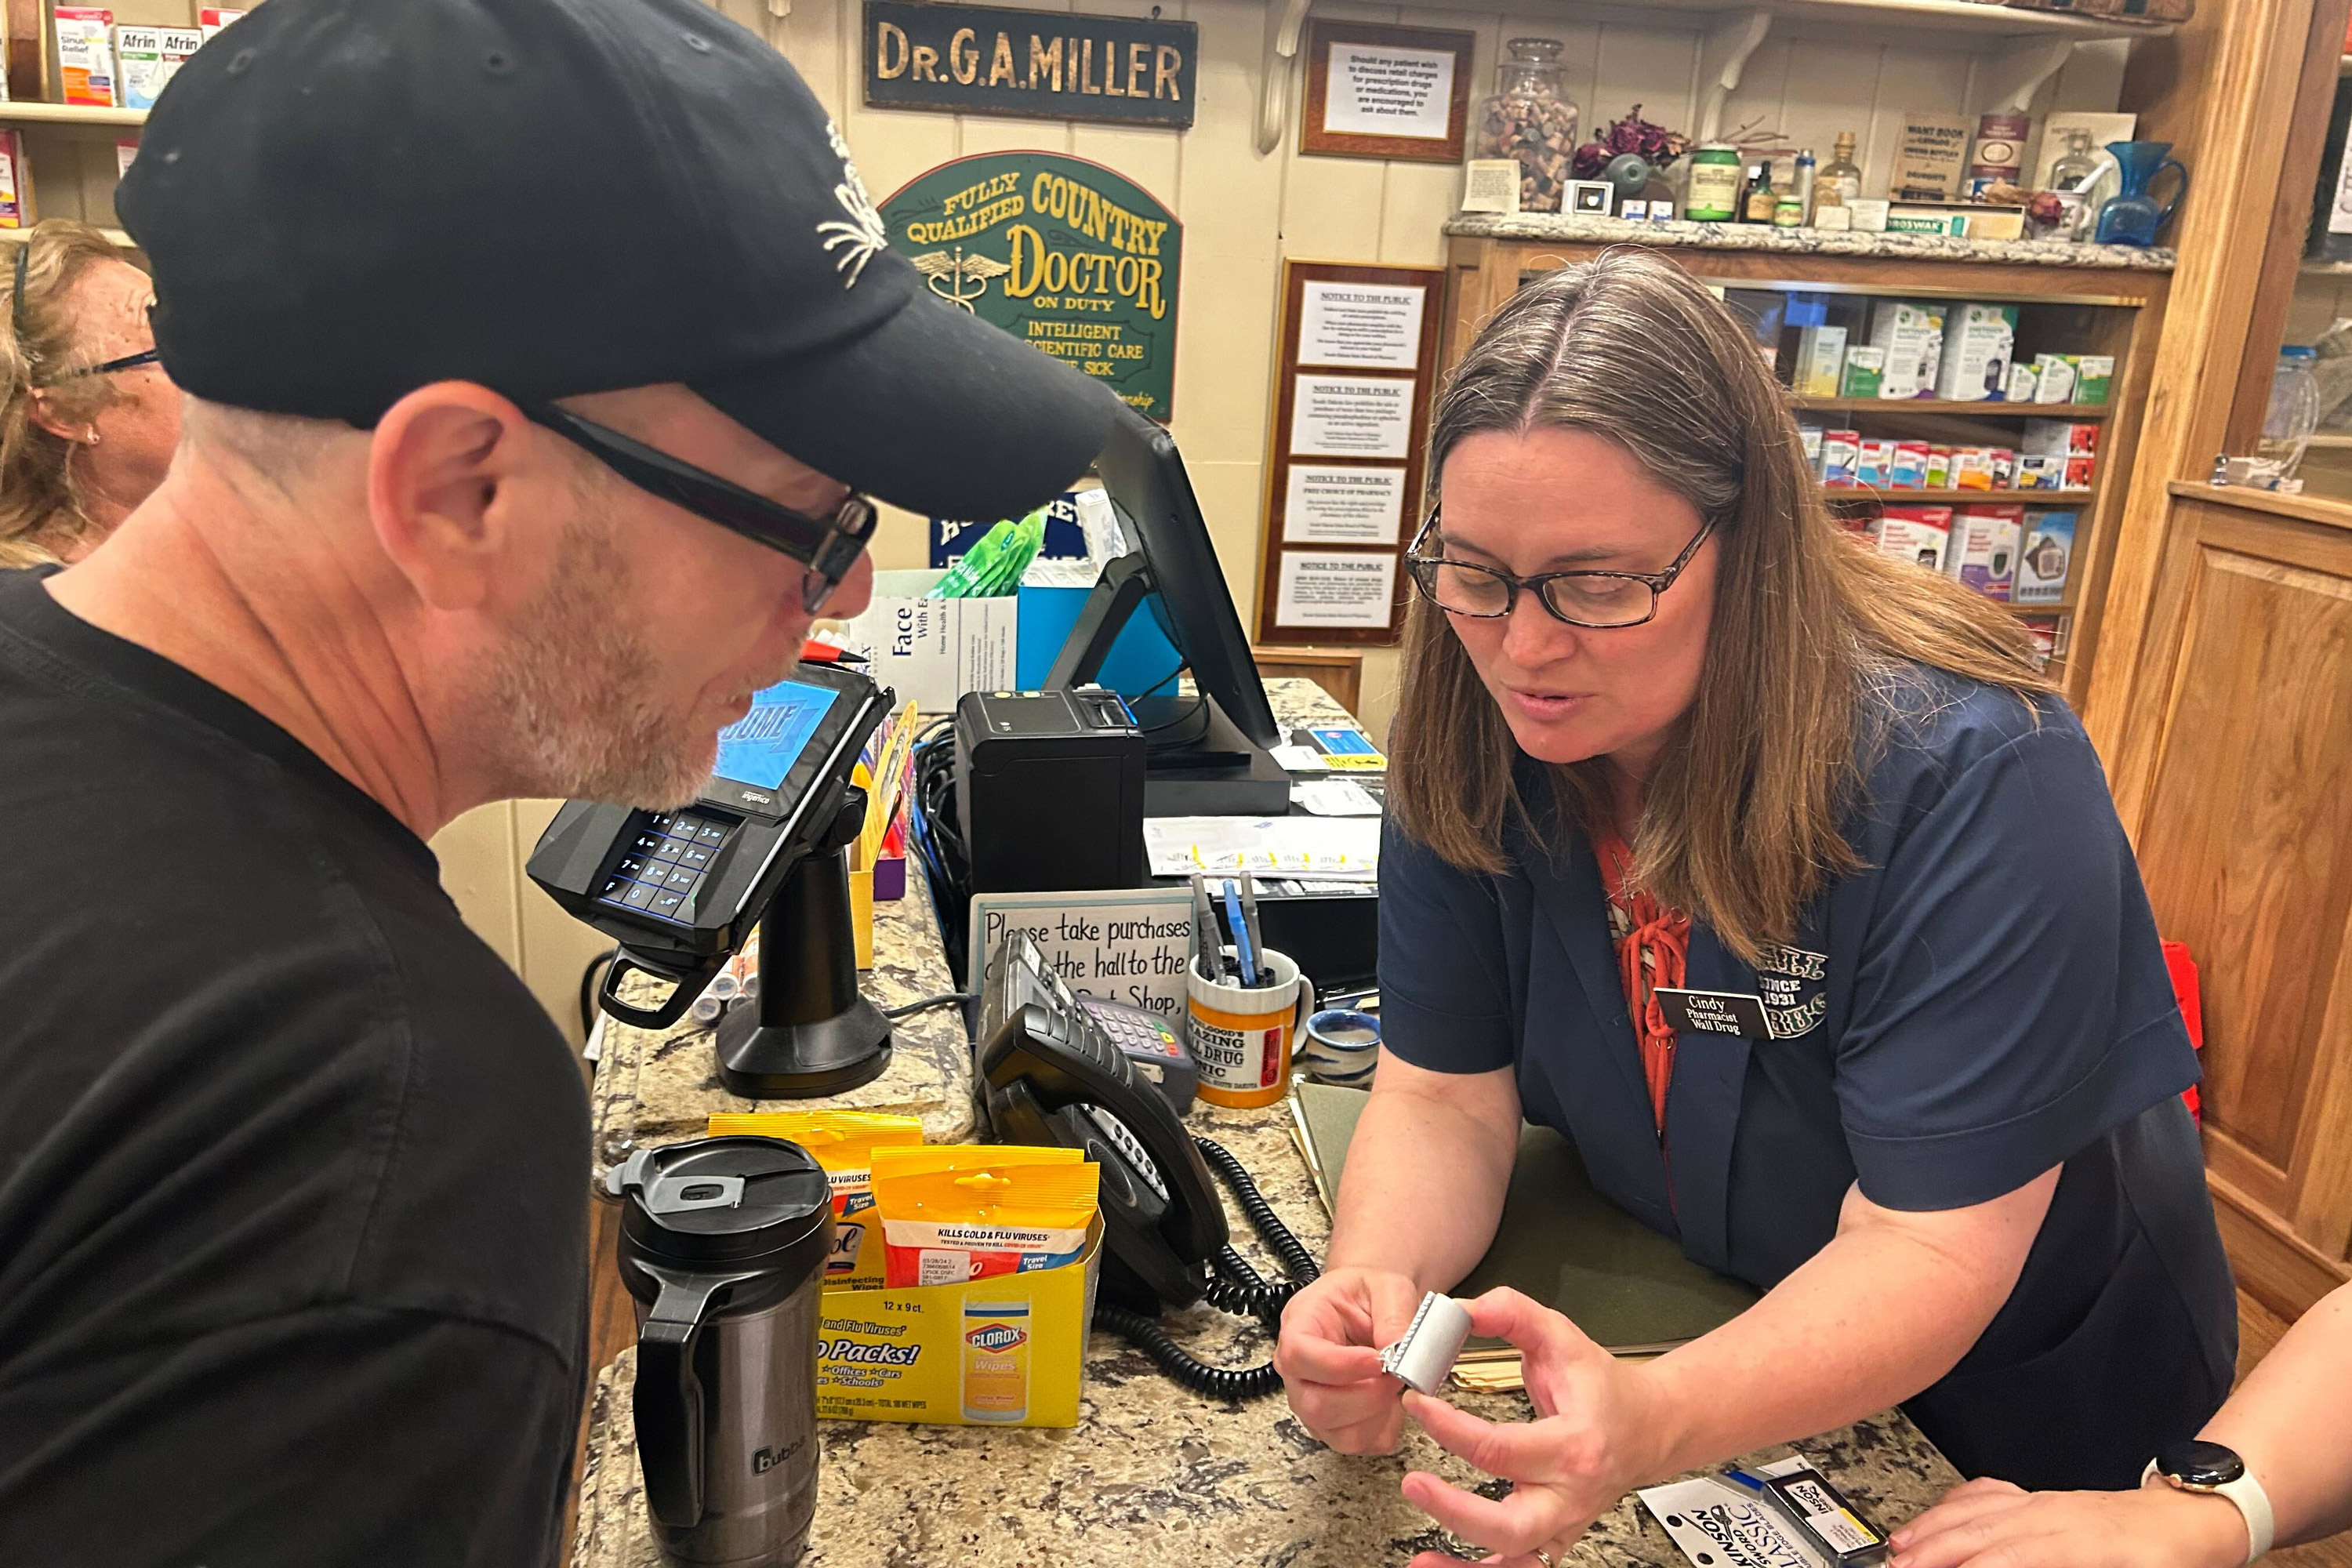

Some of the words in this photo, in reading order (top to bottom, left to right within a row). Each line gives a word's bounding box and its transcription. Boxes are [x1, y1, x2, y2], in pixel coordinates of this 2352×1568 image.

[123, 34, 156, 49] Afrin
[165, 36, 198, 51] Afrin
[1350, 55, 1377, 64] Should
[1378, 59, 1392, 67] any
[1359, 66, 1386, 74] discuss
[1409, 71, 1438, 79] charges
[1365, 78, 1410, 86] prescription
[1411, 80, 1432, 89] drugs
[1365, 87, 1412, 96] medications,
[1371, 98, 1414, 107] encouraged
[943, 172, 1021, 216] FULLY
[906, 194, 1025, 245] QUALIFIED
[1032, 172, 1168, 256] COUNTRY
[1033, 296, 1058, 309] ON
[1065, 297, 1116, 311] DUTY
[1320, 292, 1351, 302] NOTICE
[1354, 294, 1365, 303] TO
[1367, 295, 1381, 303] THE
[1384, 296, 1411, 305] PUBLIC
[1028, 321, 1122, 340] INTELLIGENT
[1107, 344, 1145, 360] CARE
[1084, 361, 1116, 376] SICK
[1313, 385, 1341, 394] NOTICE
[1374, 388, 1400, 397] PUBLIC
[1305, 475, 1334, 484] NOTICE
[1337, 476, 1347, 485] TO
[1365, 477, 1392, 486] PUBLIC
[1301, 562, 1327, 571] NOTICE
[1357, 564, 1383, 572] PUBLIC
[892, 608, 913, 657] Face
[917, 612, 928, 639] With
[742, 792, 770, 804] ingenico
[677, 822, 685, 830] 2
[702, 828, 710, 837] 3
[637, 837, 646, 846] 4
[661, 844, 670, 852] 5
[686, 850, 695, 858] 6
[622, 859, 631, 869] 7
[647, 866, 655, 876] 8
[670, 873, 680, 882] 9
[605, 882, 615, 891] F
[631, 889, 641, 898] 0
[985, 912, 1048, 943] Plese
[1055, 913, 1099, 941] take
[1108, 916, 1190, 949] purchases
[1054, 950, 1085, 978] the
[1095, 947, 1125, 978] hall
[1129, 949, 1147, 975] to
[1152, 945, 1185, 975] the
[1130, 985, 1181, 1015] Shop,
[1688, 995, 1725, 1013] Cindy
[1764, 991, 1796, 1006] 1931
[1686, 1008, 1738, 1023] Pharmacist
[1690, 1018, 1714, 1031] Wall
[1713, 1021, 1741, 1036] Drug
[1190, 1023, 1245, 1049] AZING
[1204, 1045, 1245, 1065] DRUG
[839, 1174, 872, 1183] VIRUSES
[849, 1194, 873, 1205] Travel
[853, 1201, 869, 1210] Size
[938, 1229, 963, 1238] KILLS
[964, 1230, 986, 1239] COLD
[995, 1232, 1012, 1240] FLU
[1013, 1232, 1048, 1241] VIRUSES
[1023, 1255, 1047, 1265] Travel
[884, 1301, 894, 1310] 12
[906, 1303, 911, 1312] 9
[824, 1319, 844, 1331] and
[846, 1319, 862, 1333] Flu
[971, 1328, 1022, 1348] CLOROX
[829, 1339, 921, 1365] Packs!
[831, 1366, 867, 1376] Offices
[878, 1369, 902, 1378] Cars
[975, 1360, 1015, 1372] Wipes
[1747, 1502, 1775, 1530] BLADES
[1728, 1504, 1799, 1568] LASSIC
[1772, 1530, 1794, 1550] EDGE
[1733, 1530, 1772, 1566] SWORD
